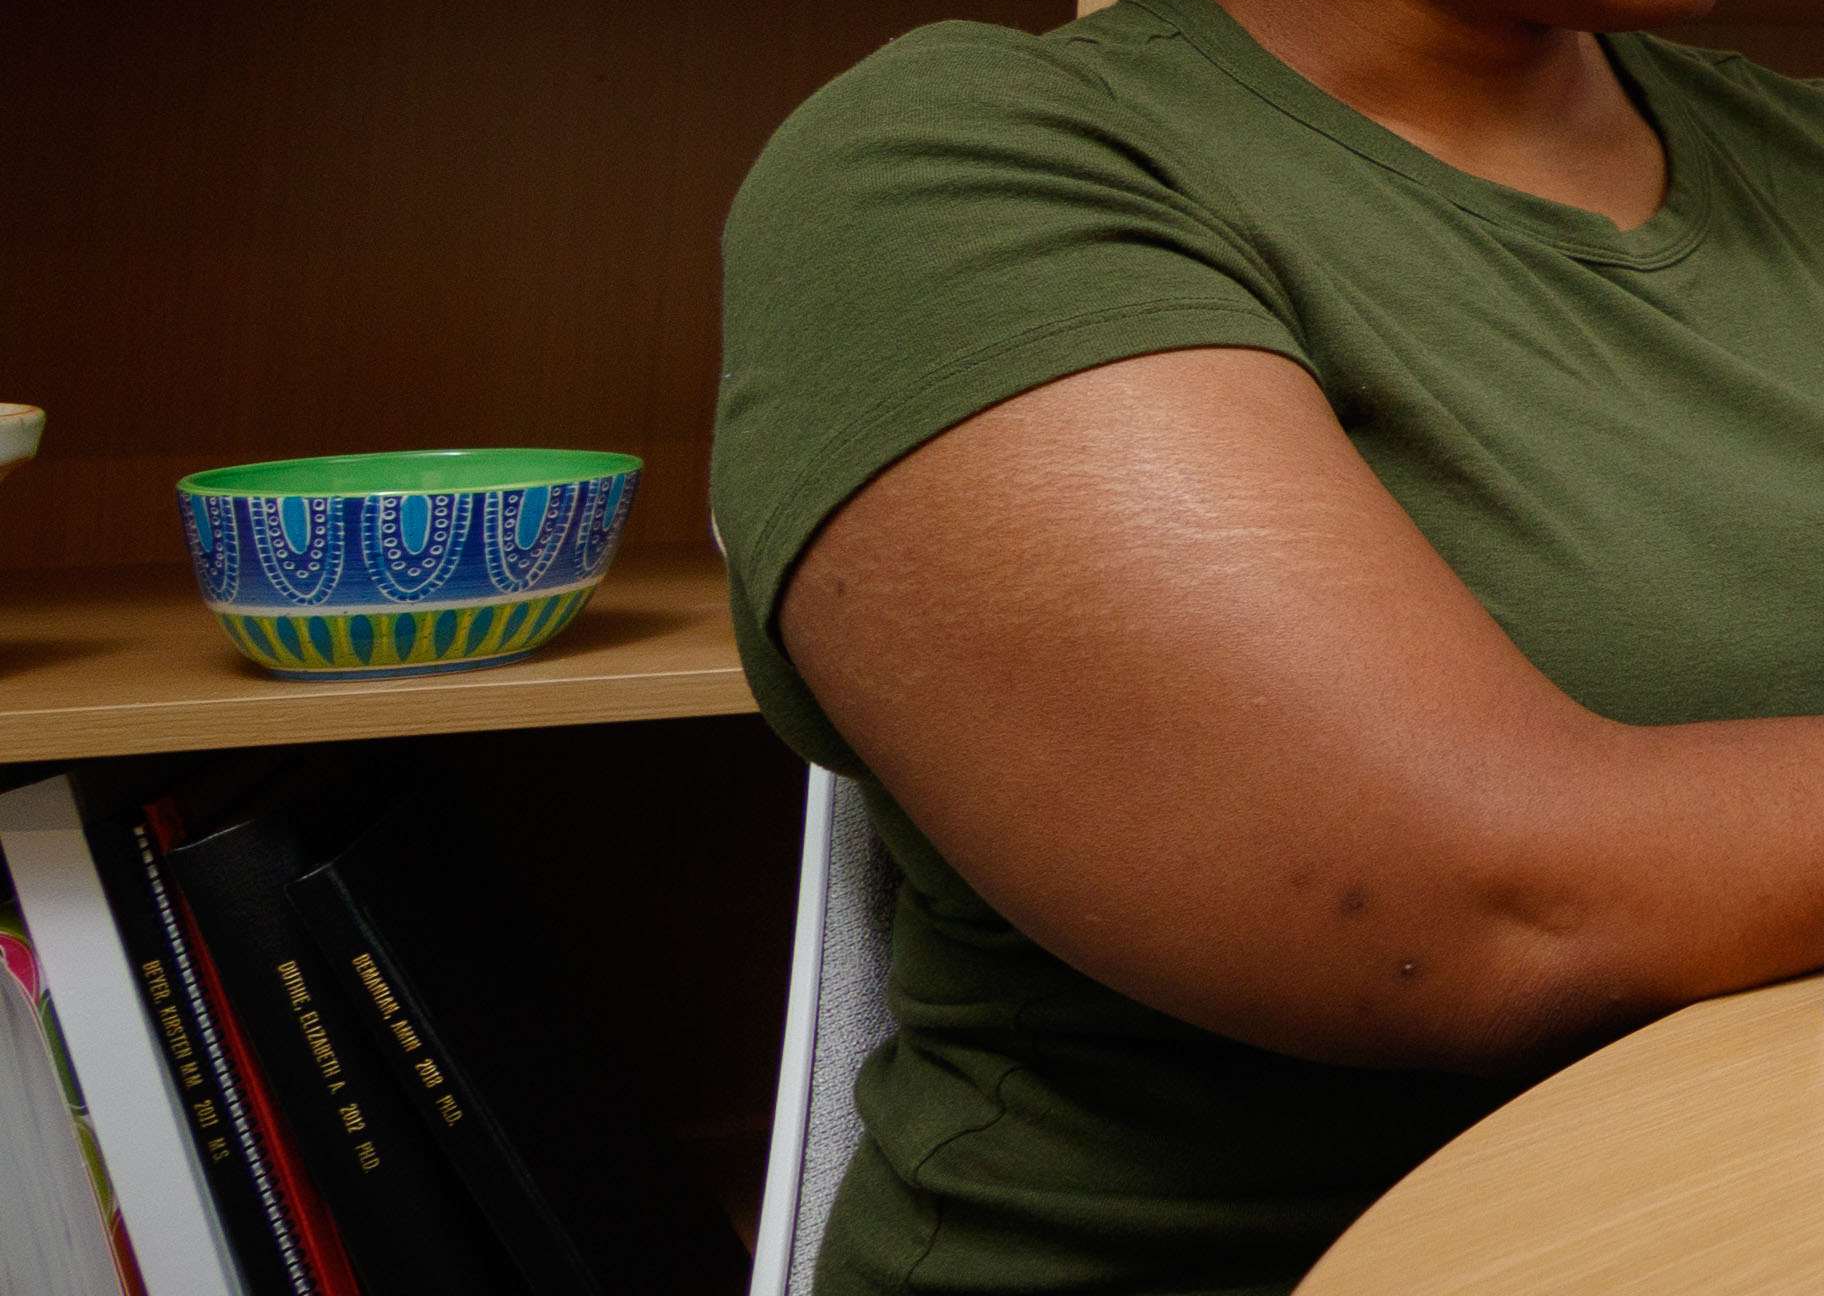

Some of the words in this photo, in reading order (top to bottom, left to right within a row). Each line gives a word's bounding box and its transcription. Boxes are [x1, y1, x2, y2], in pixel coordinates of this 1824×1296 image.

[142, 959, 173, 1005] BEYER,
[159, 1004, 194, 1061] KIRSTEN
[192, 1098, 221, 1129] 2011
[277, 959, 313, 1013] DUTHIE,
[299, 1009, 344, 1080] ELIZABETH
[337, 1102, 367, 1135] 2012
[389, 1017, 423, 1054] AMIN
[414, 1057, 446, 1090] 2018
